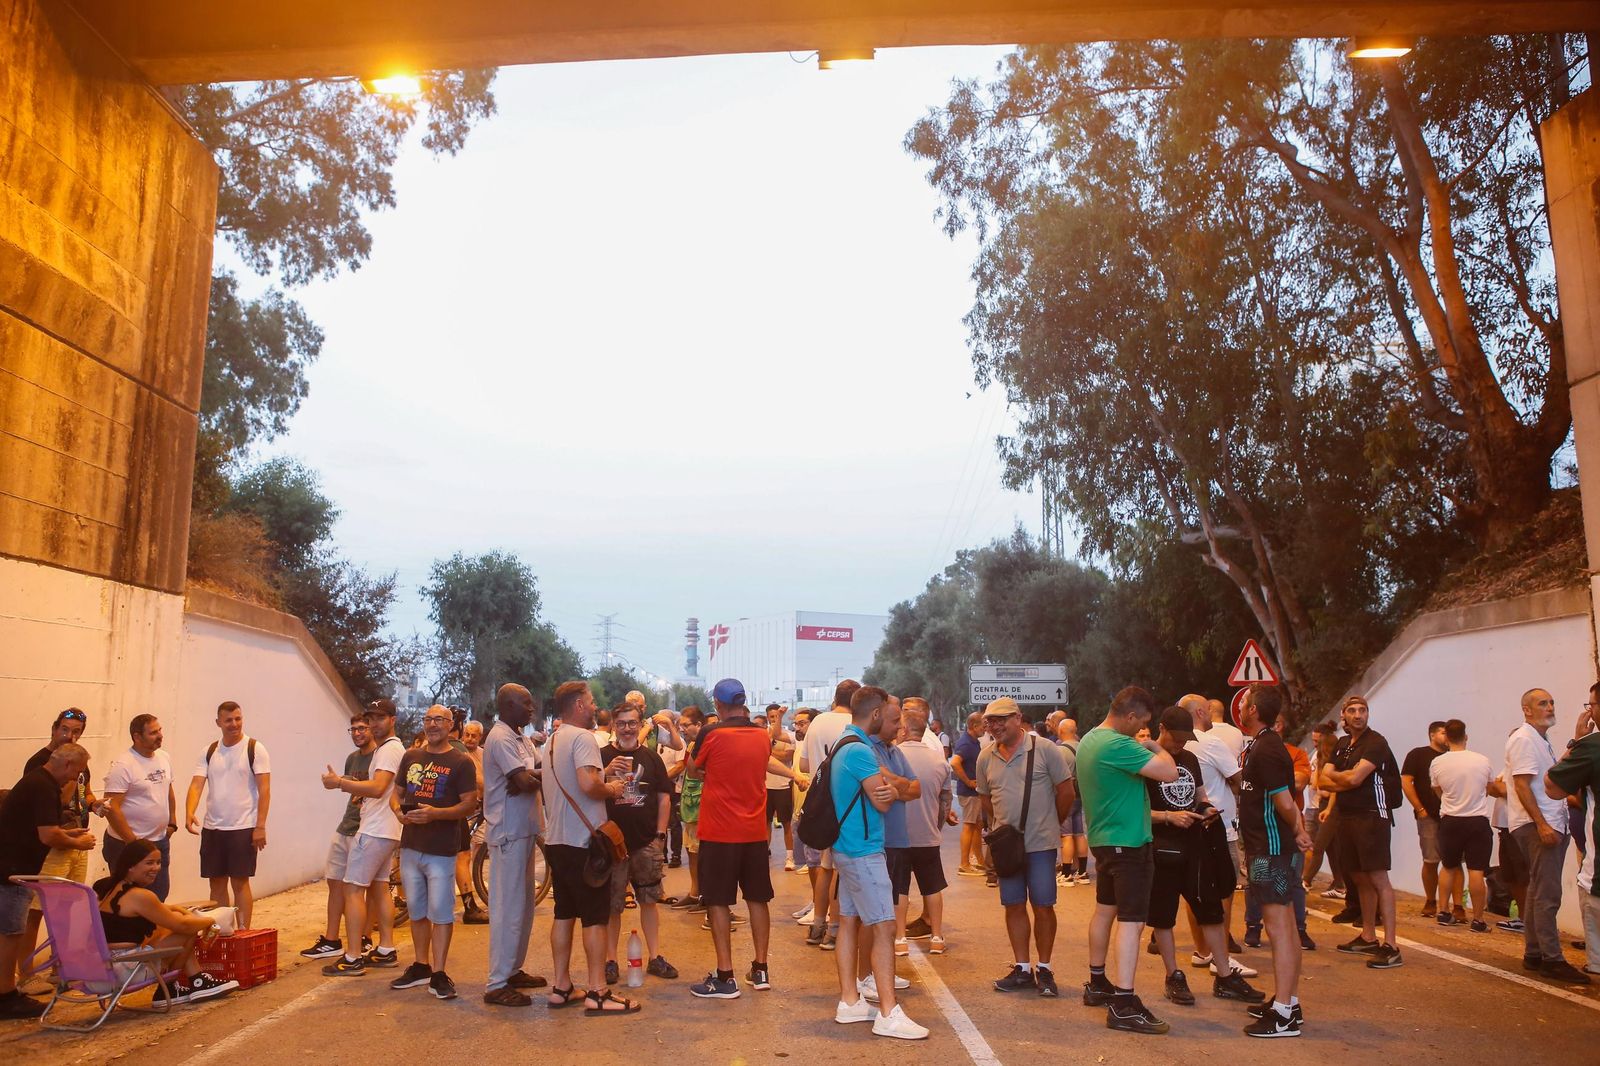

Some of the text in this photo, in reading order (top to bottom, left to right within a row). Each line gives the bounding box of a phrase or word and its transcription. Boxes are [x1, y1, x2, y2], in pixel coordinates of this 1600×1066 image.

[431, 765, 451, 775] HAVE
[425, 771, 438, 779] NO
[422, 784, 435, 792] I'M
